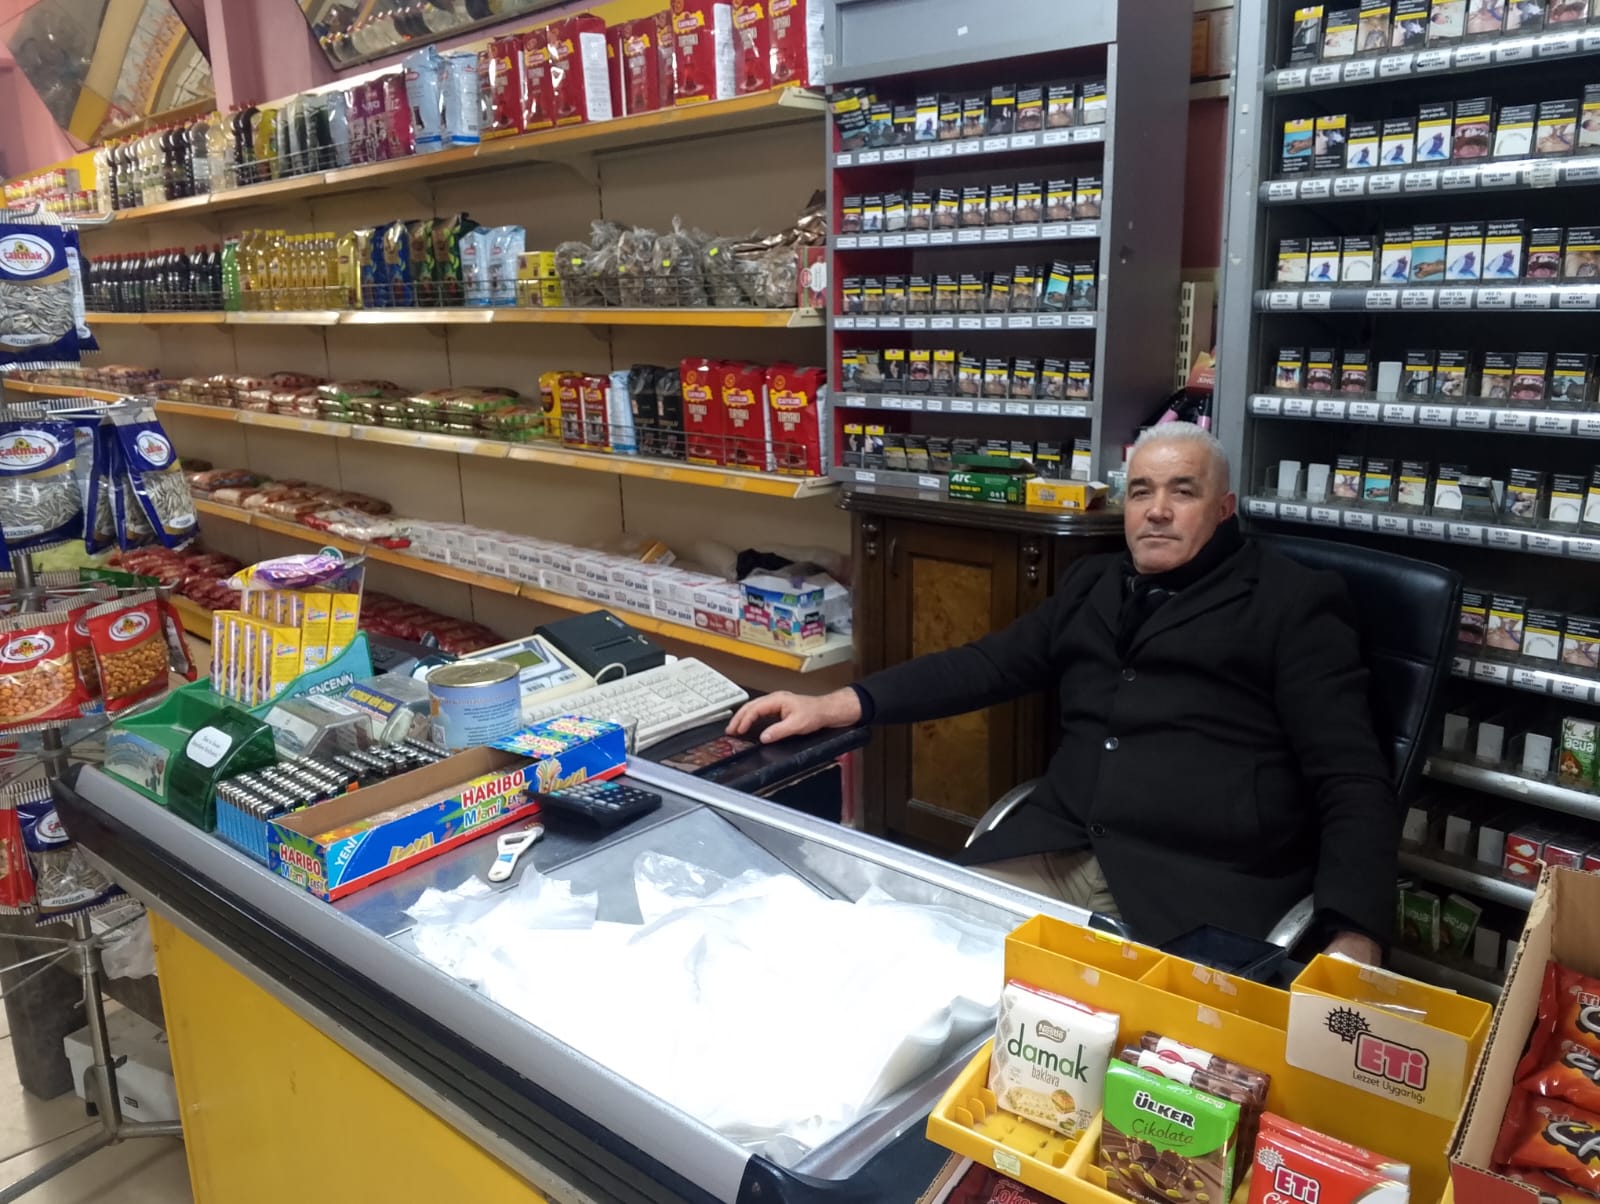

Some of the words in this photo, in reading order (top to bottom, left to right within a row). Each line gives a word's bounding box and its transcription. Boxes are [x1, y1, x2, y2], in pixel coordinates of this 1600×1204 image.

[461, 769, 523, 809] HARIBO
[279, 842, 321, 877] HARIBO
[1007, 1023, 1089, 1084] damak
[1031, 1064, 1061, 1088] baklava
[1352, 1070, 1380, 1088] Lezzet
[1382, 1081, 1425, 1104] Uygarlığı
[1134, 1090, 1195, 1129] ÜLKER
[1131, 1117, 1194, 1146] Çikolata
